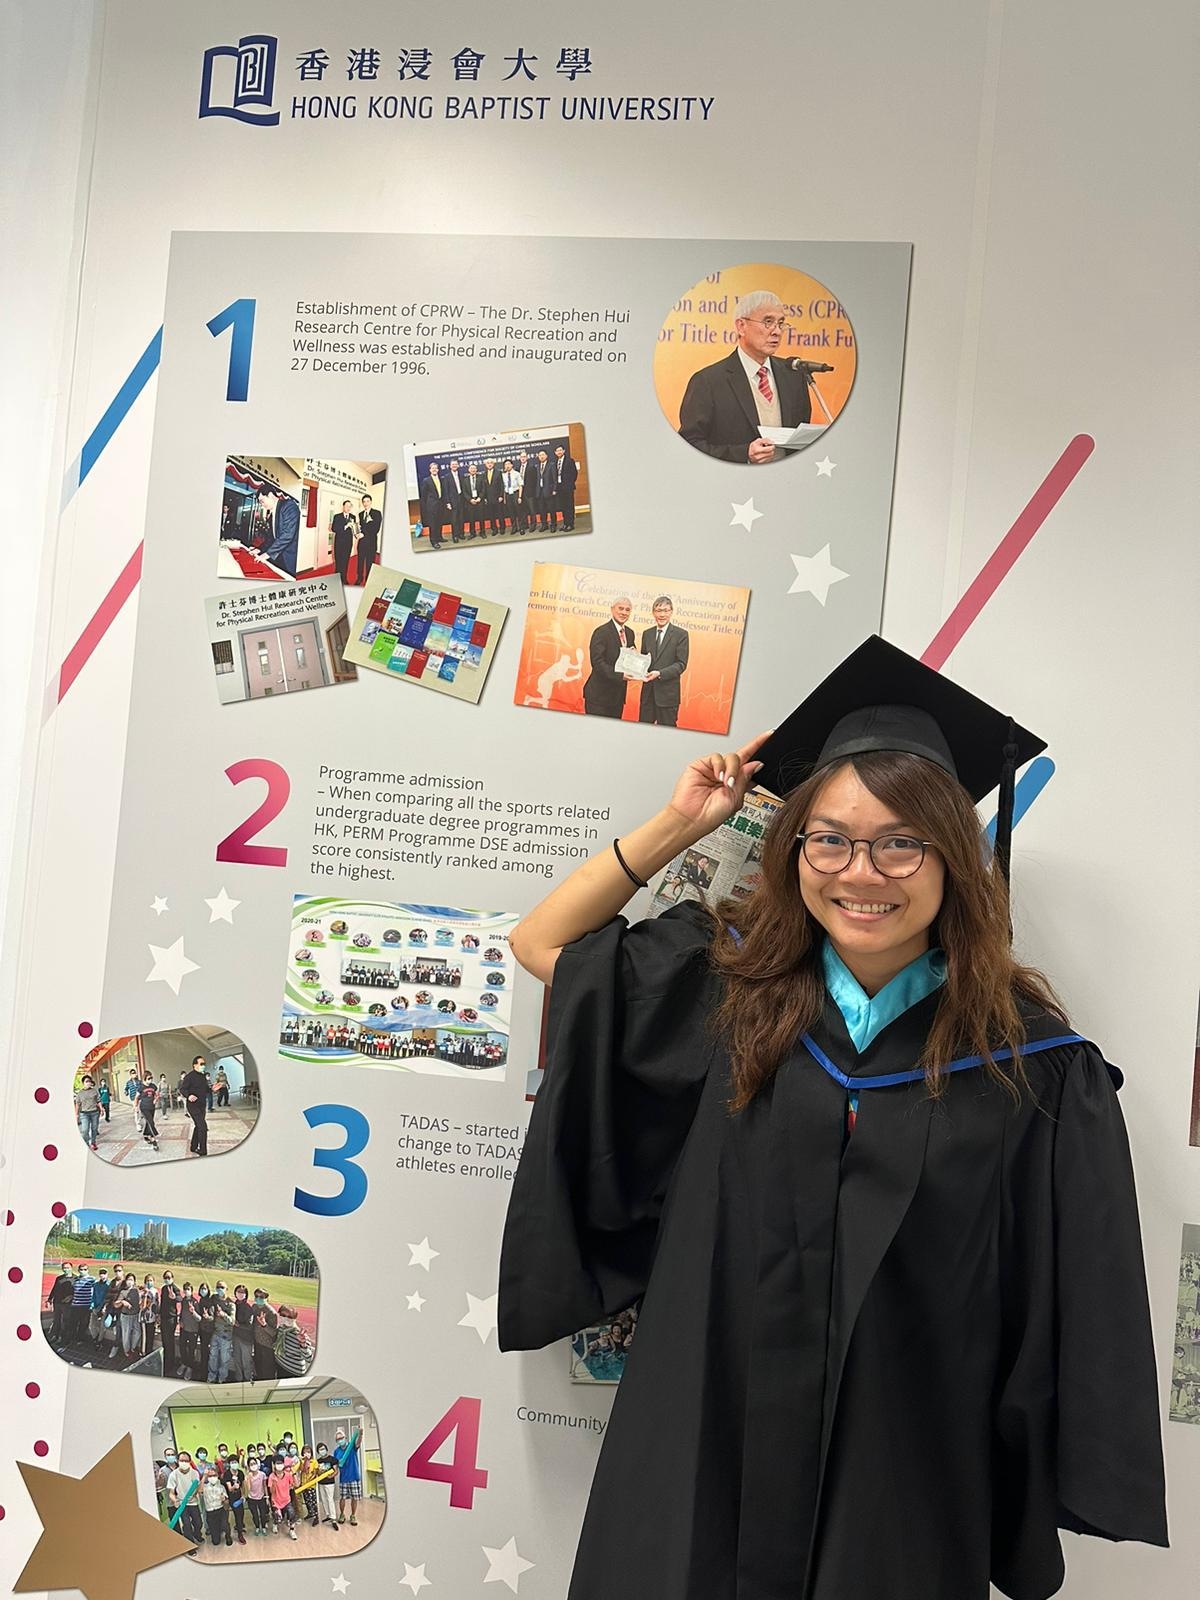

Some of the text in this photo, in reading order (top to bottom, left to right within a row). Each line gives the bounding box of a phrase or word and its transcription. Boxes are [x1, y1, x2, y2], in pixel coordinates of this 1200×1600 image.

[296, 47, 592, 81] 香港浸會大學
[292, 96, 714, 120] HONG KONG BAPTIST UNIVERSITY
[297, 302, 397, 316] Establishment
[402, 304, 417, 316] of
[420, 305, 464, 317] CPRW
[480, 306, 506, 319] The
[512, 307, 532, 320] Dr.
[538, 308, 599, 325] Stephen
[605, 310, 630, 323] Hui
[699, 296, 728, 314] and
[295, 321, 617, 342] Research Centre for Physical Recreation and
[680, 323, 717, 343] Title
[723, 329, 738, 344] to
[788, 328, 830, 347] Frank
[206, 299, 256, 401] 1
[293, 339, 626, 363] Wellness was established and inaugurated on
[291, 358, 429, 375] 27 December 1996.
[574, 571, 629, 597] Celebration
[675, 595, 726, 611] Anniversary
[227, 615, 254, 626] Physical
[255, 610, 290, 621] Recreation
[291, 606, 304, 614] and
[305, 601, 336, 611] Wellness
[232, 608, 260, 618] Stephen
[261, 604, 273, 612] Hui
[274, 599, 305, 609] Research
[305, 594, 328, 604] Centre
[320, 766, 483, 790] Programme admission
[215, 758, 291, 867] 2
[330, 786, 370, 801] When
[376, 792, 453, 812] comparing
[458, 796, 474, 809] all
[479, 798, 502, 811] the
[507, 803, 552, 816] sports
[558, 805, 610, 820] related
[315, 805, 597, 840] undergraduate degree programmes in
[315, 823, 588, 858] HK, PERM Programme DSE admission
[311, 861, 394, 881] the highest.
[312, 845, 553, 878] score consistently ranked among
[400, 1115, 449, 1132] TADAS
[466, 1124, 519, 1139] started
[398, 1135, 451, 1155] change
[457, 1142, 471, 1155] to
[294, 1103, 370, 1217] 3
[396, 1156, 455, 1174] athletes
[516, 1406, 608, 1435] Community
[406, 1396, 488, 1510] 4
